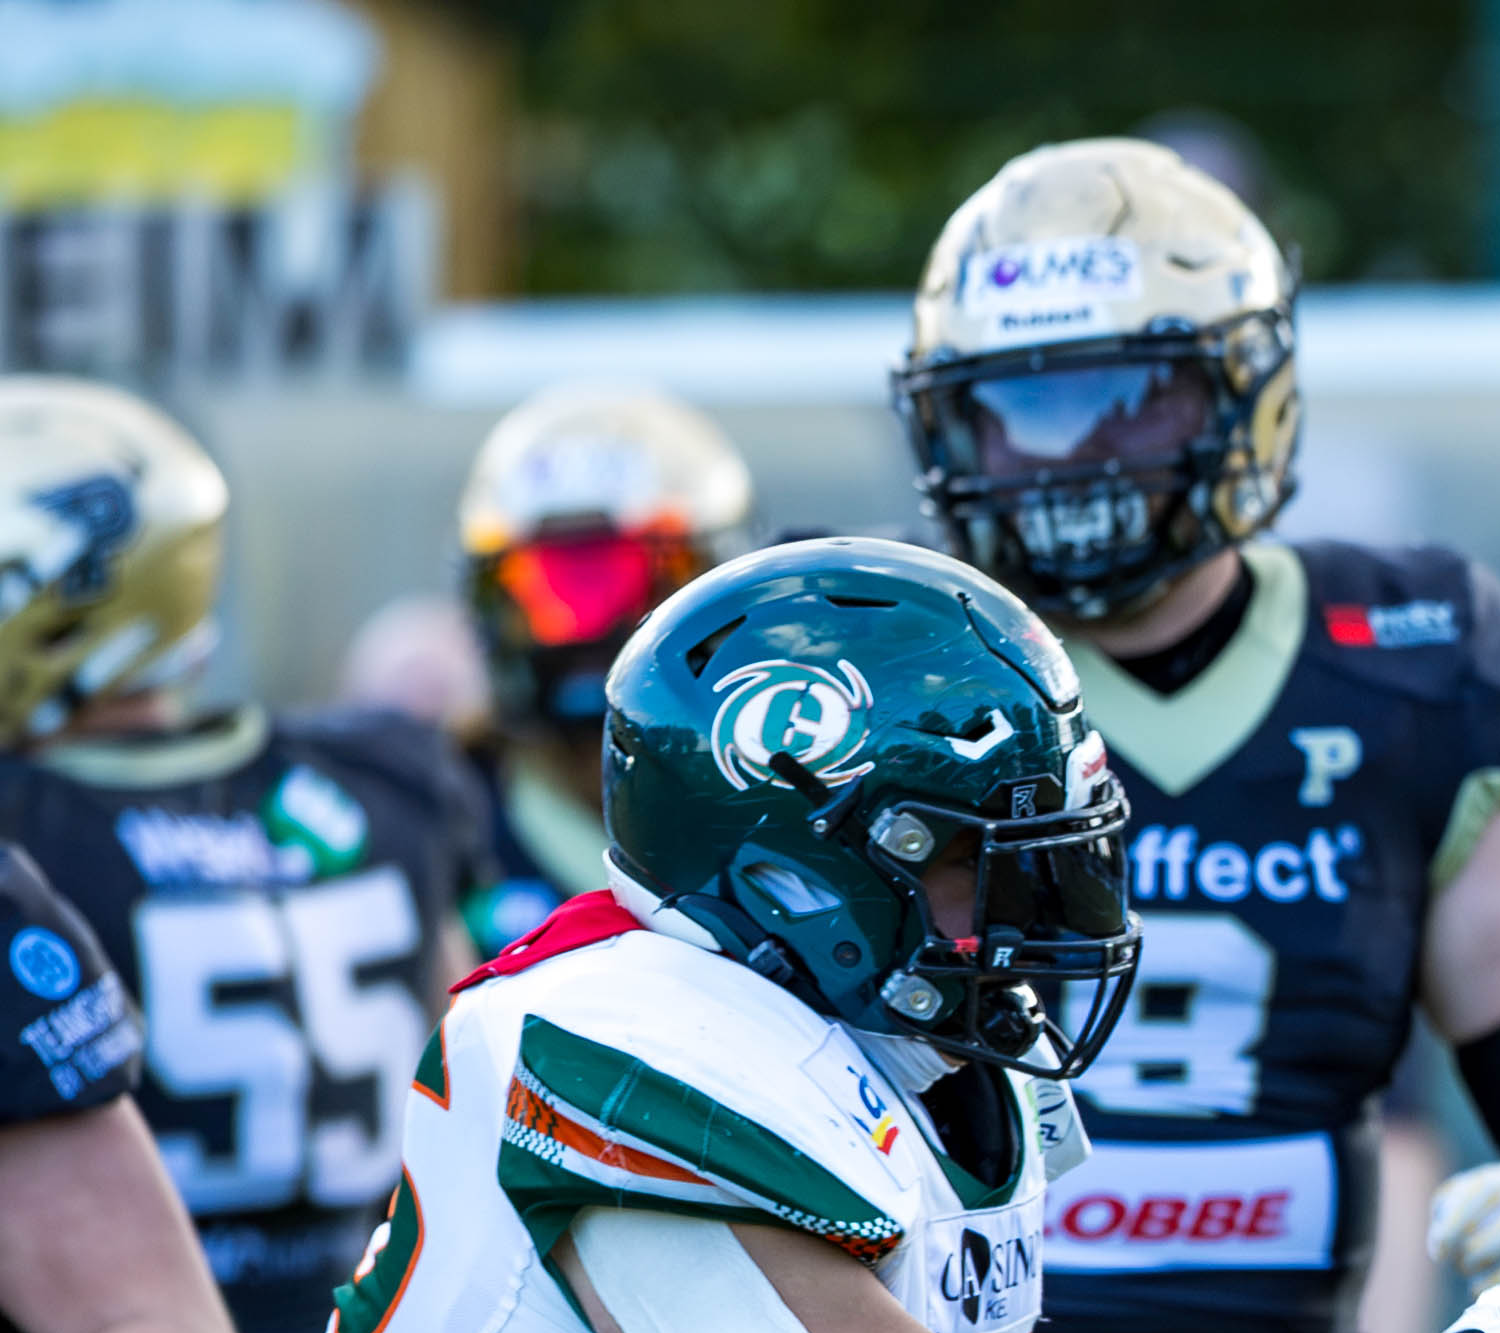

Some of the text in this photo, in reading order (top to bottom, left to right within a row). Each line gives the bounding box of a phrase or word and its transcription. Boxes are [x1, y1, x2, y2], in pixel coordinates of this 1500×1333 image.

[1290, 725, 1363, 807] P
[1130, 824, 1350, 901] ffect
[130, 862, 422, 1214] 55
[1043, 1190, 1291, 1244] OBBE
[941, 1230, 1042, 1302] CASIN
